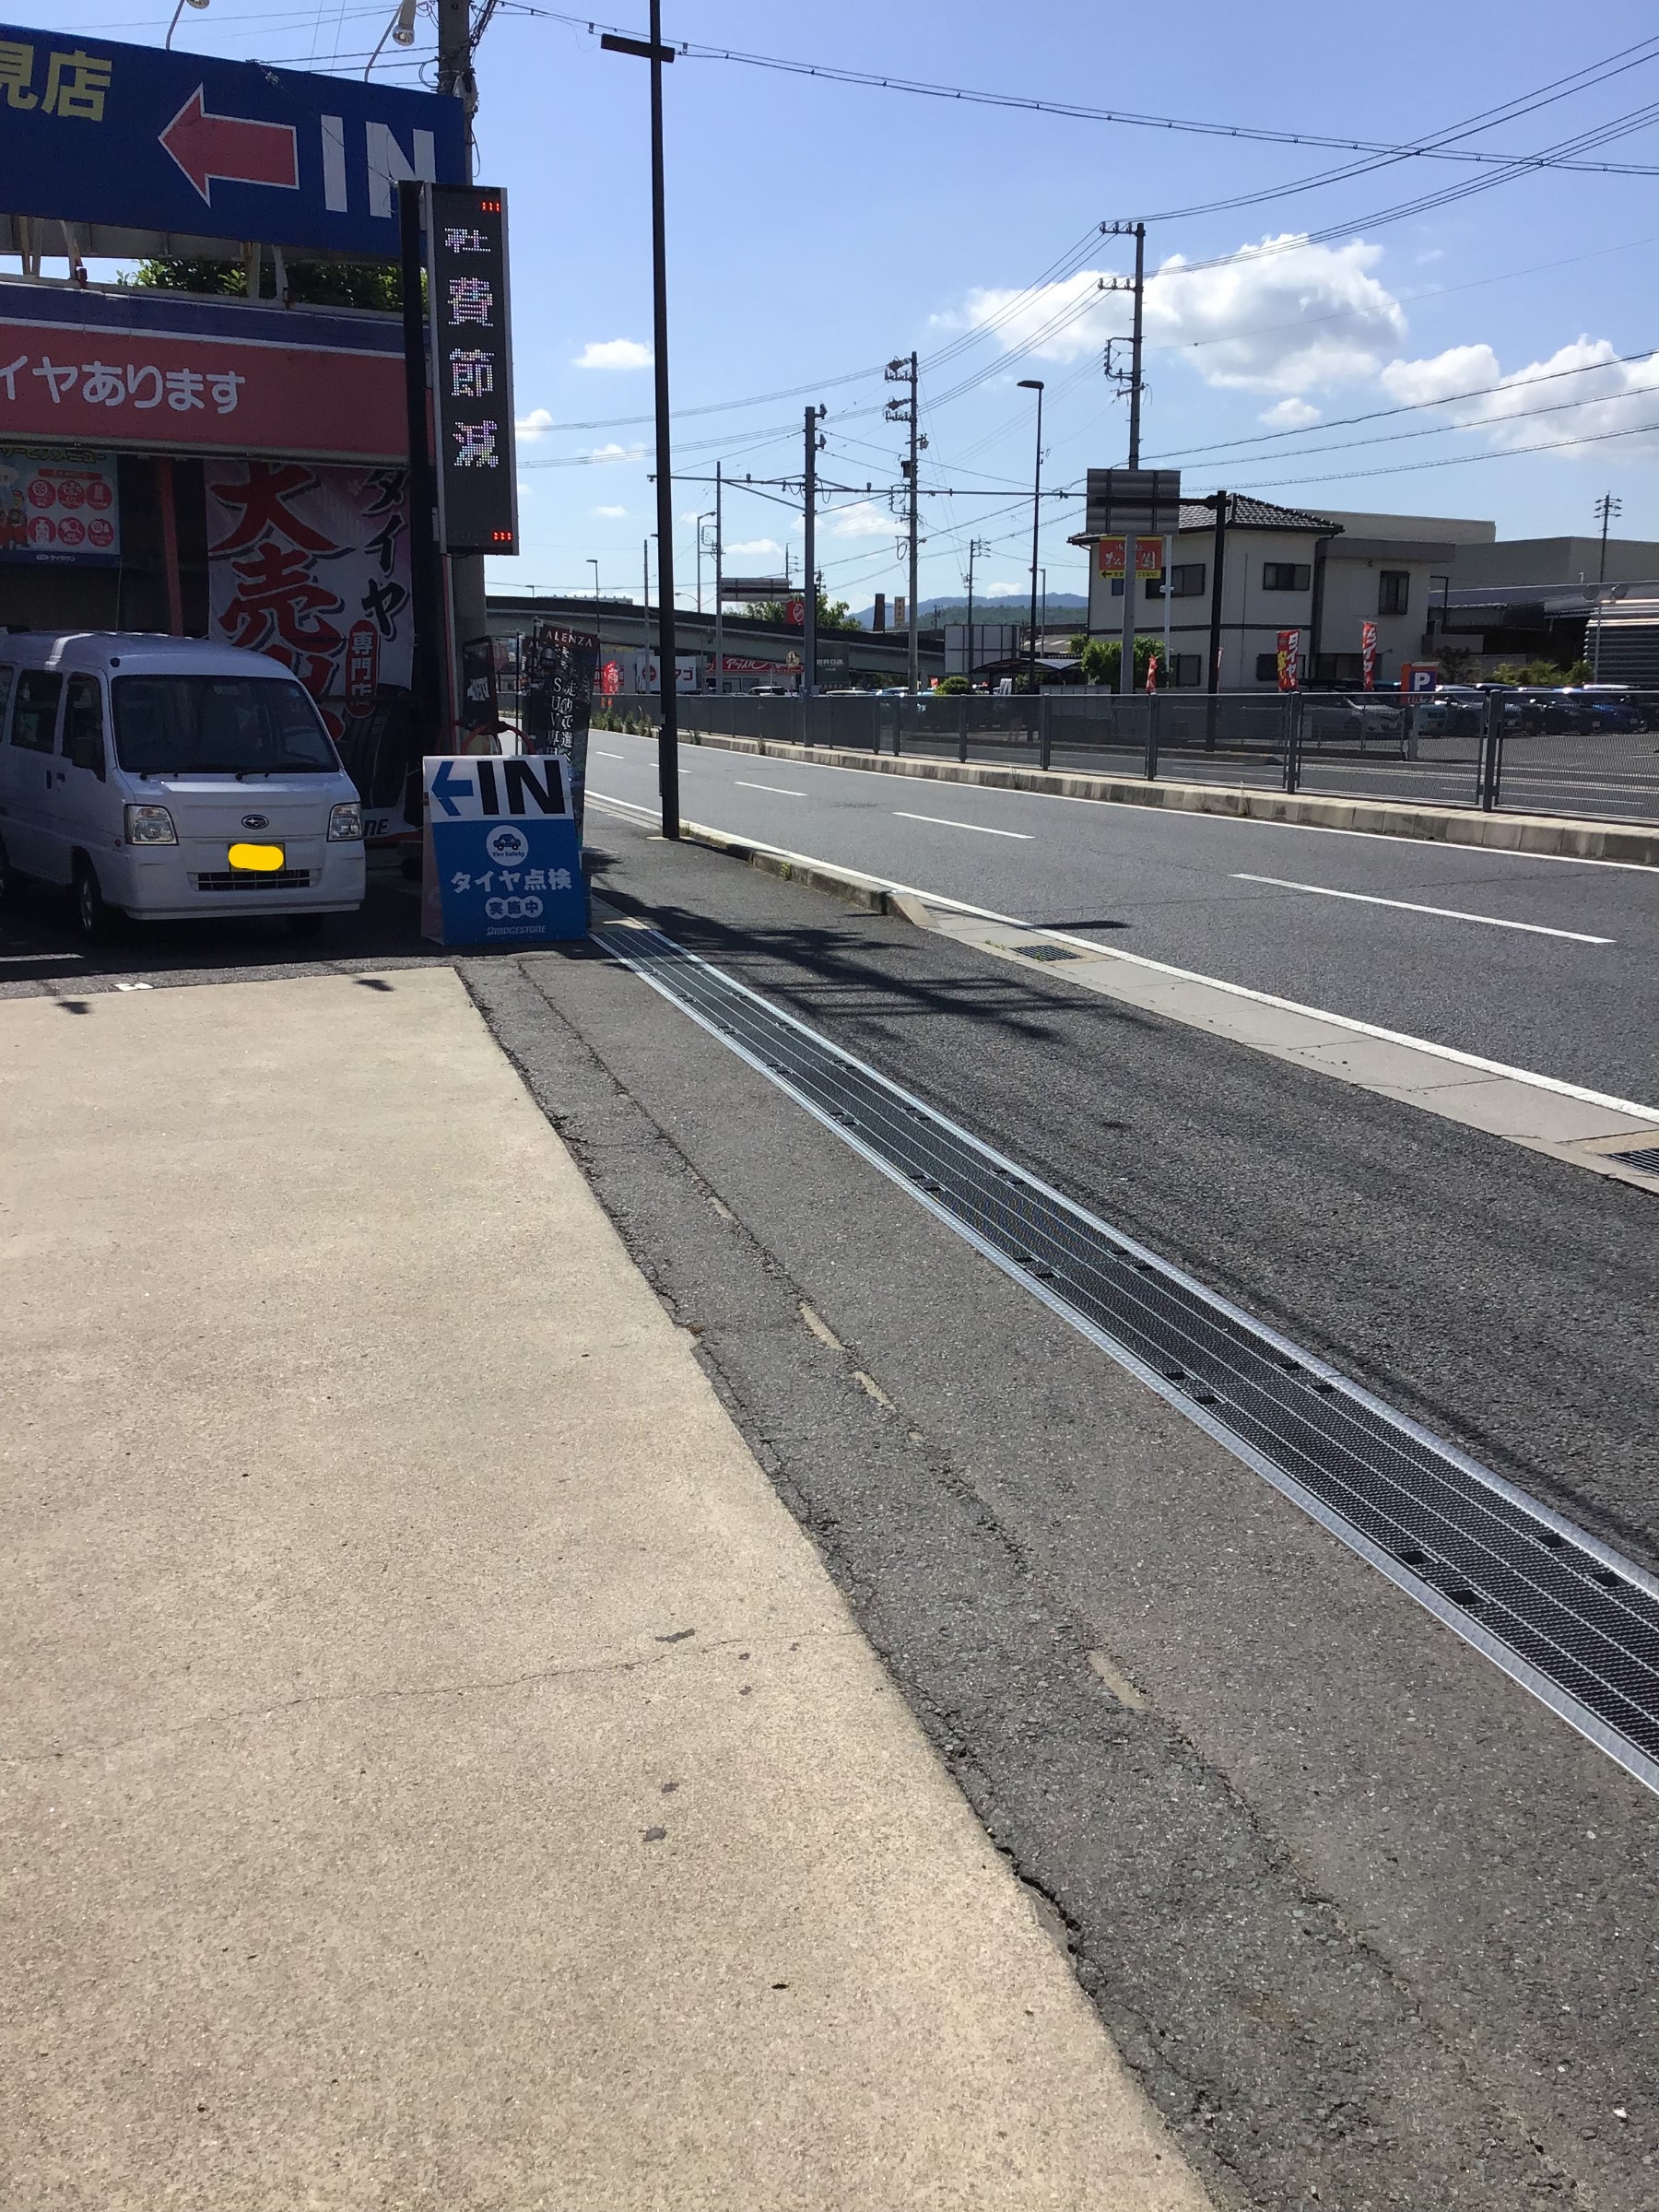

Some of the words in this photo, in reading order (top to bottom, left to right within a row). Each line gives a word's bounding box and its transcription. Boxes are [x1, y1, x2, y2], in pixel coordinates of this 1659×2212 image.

[321, 114, 437, 218] IN
[361, 468, 411, 642] タイヤ
[546, 629, 593, 648] ALENZA
[351, 631, 373, 706] 専門店
[1415, 673, 1430, 691] P
[477, 760, 566, 816] IN
[505, 851, 525, 859] Safety
[451, 867, 572, 894] タイヤ点検
[489, 900, 539, 915] 実施中
[487, 924, 547, 935] BRIDGESTONE
